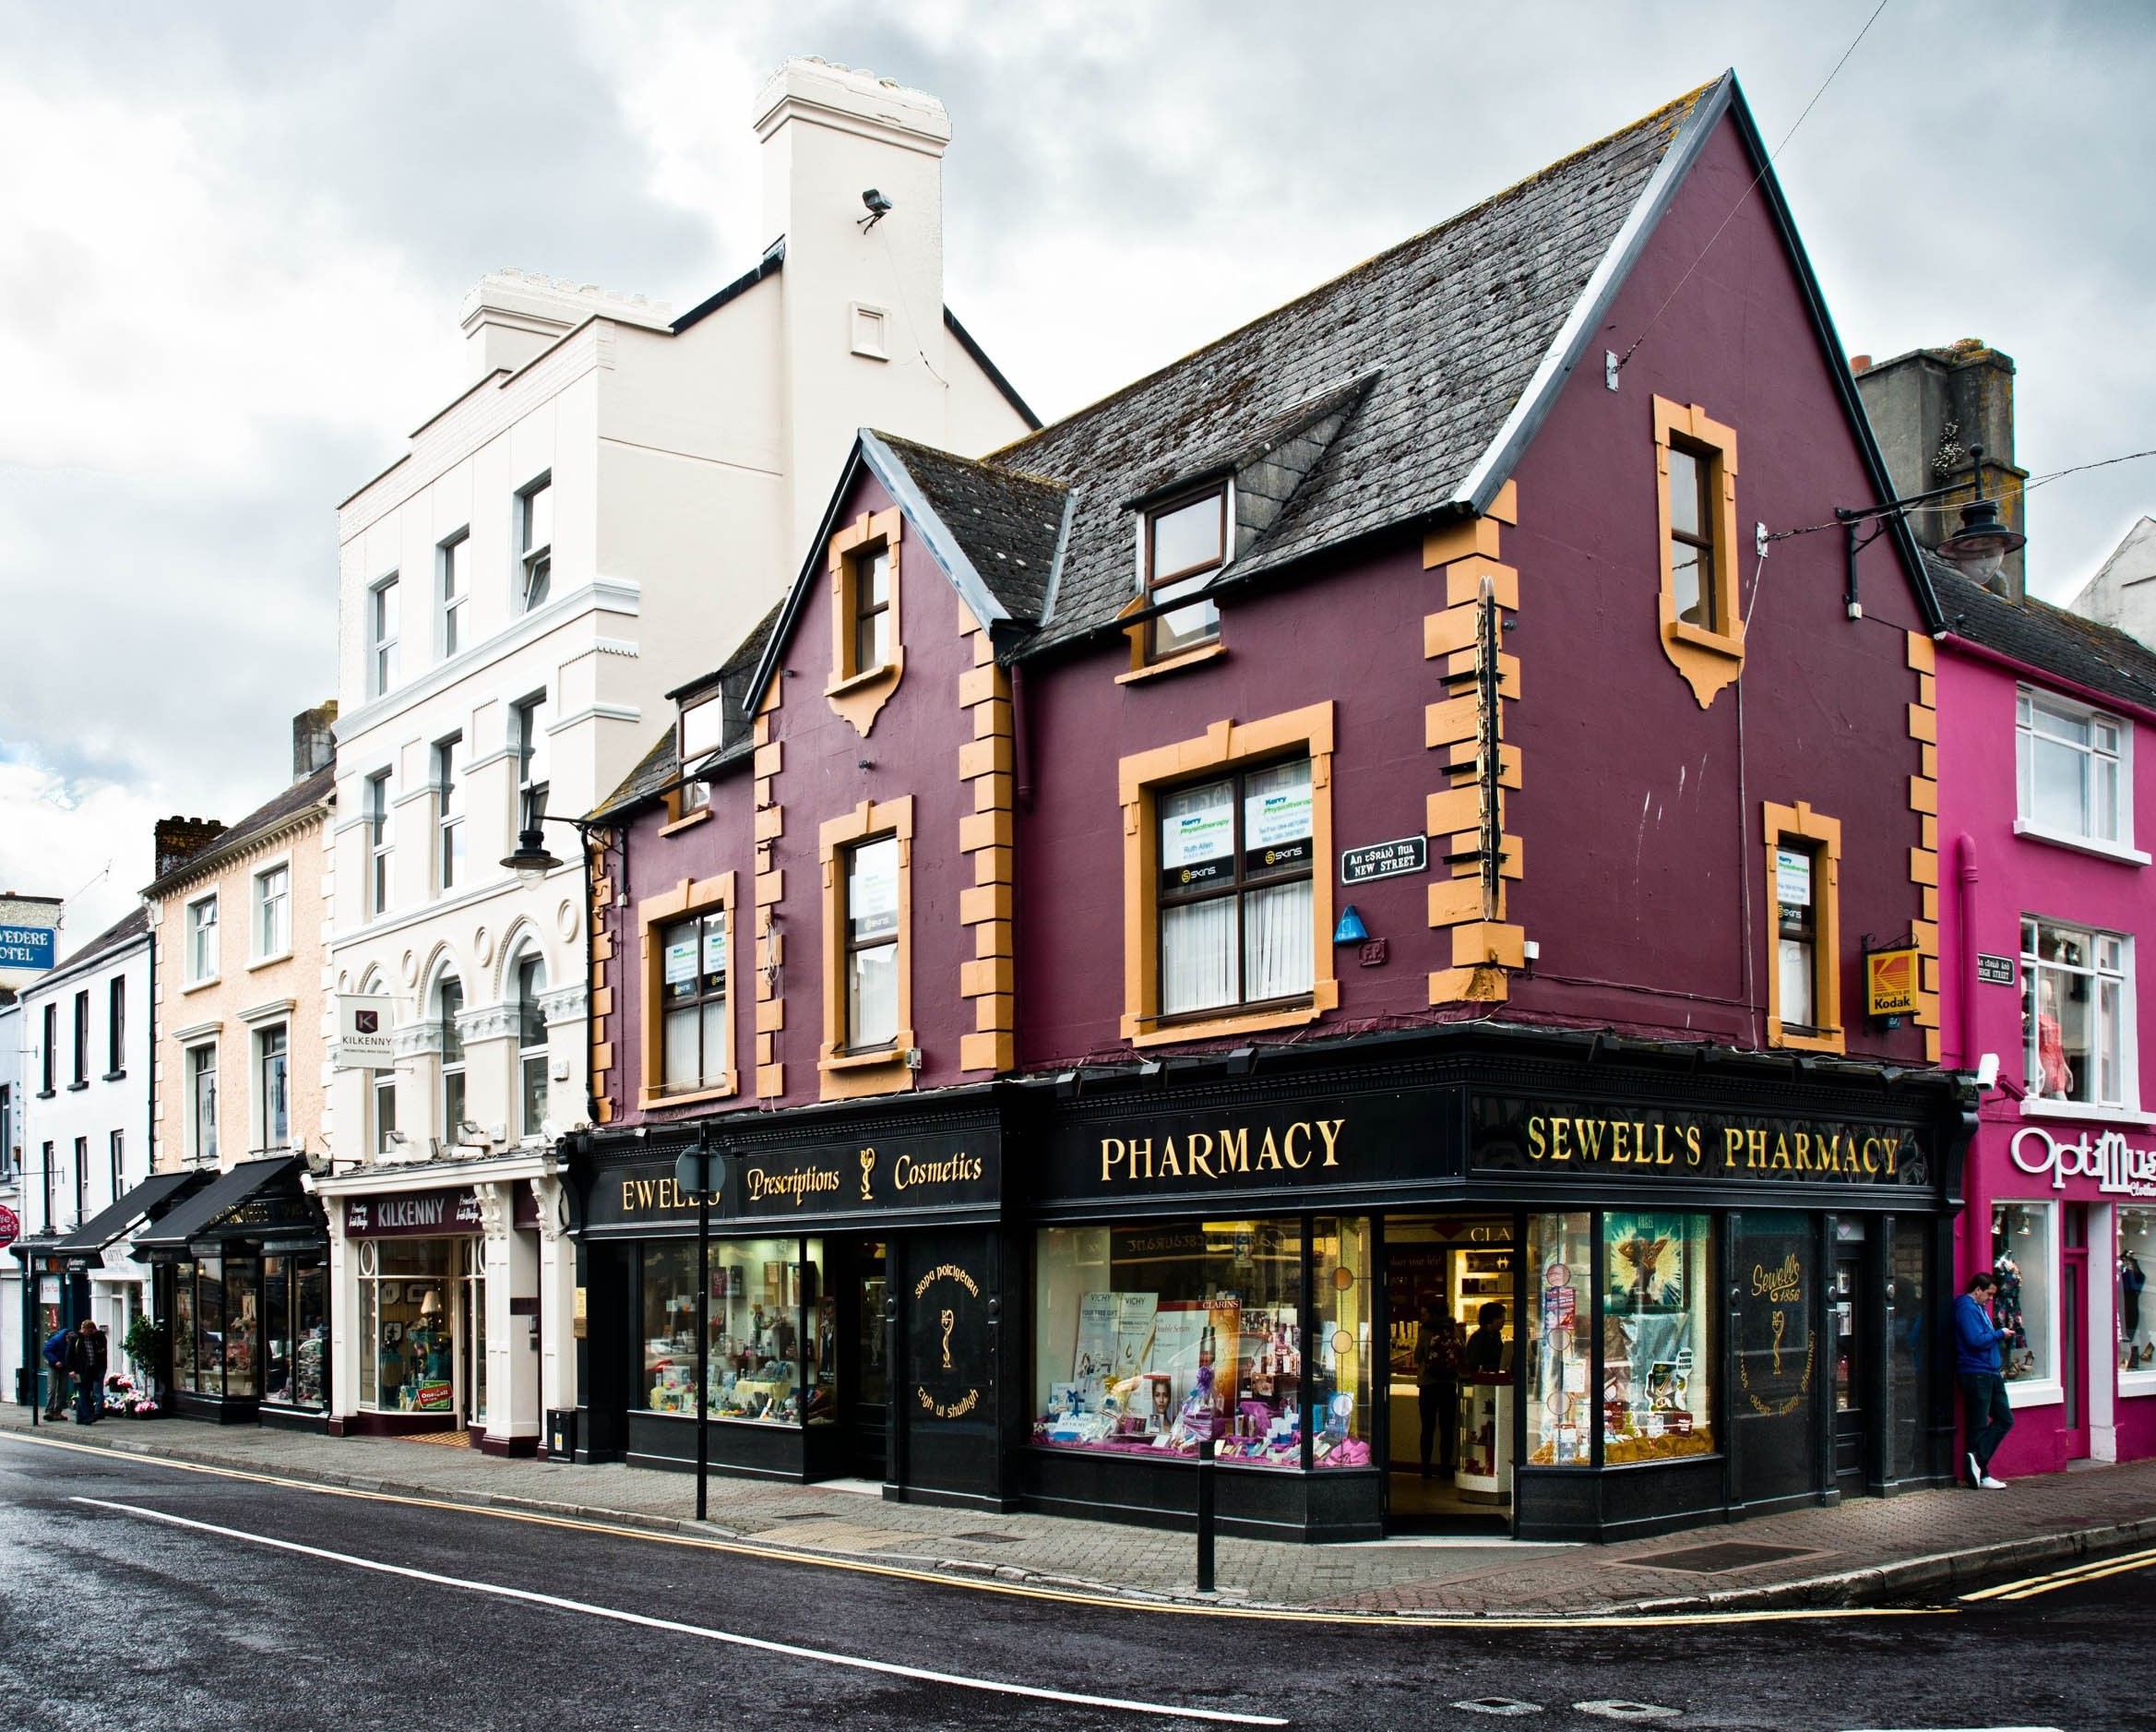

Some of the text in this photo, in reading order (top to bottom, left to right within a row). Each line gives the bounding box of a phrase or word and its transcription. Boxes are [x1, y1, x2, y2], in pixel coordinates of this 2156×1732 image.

[1180, 819, 1230, 834] Physiotherapy
[1182, 818, 1201, 827] Kerry
[1351, 854, 1362, 866] An
[1354, 855, 1415, 877] NEW STREET
[1875, 996, 1911, 1010] Kodak
[342, 1035, 392, 1046] KILKENNY
[1101, 1118, 1346, 1181] PHARMACY
[1528, 1116, 1900, 1177] SEWELL'S PHARMACY
[747, 1153, 983, 1206] Prescriptions Cosmetics
[377, 1198, 445, 1227] KILKENNY
[1090, 1294, 1111, 1302] VICHY
[1126, 1297, 1145, 1306] VICHY
[1781, 1289, 1801, 1302] 1856
[1202, 1300, 1239, 1308] CLARINS
